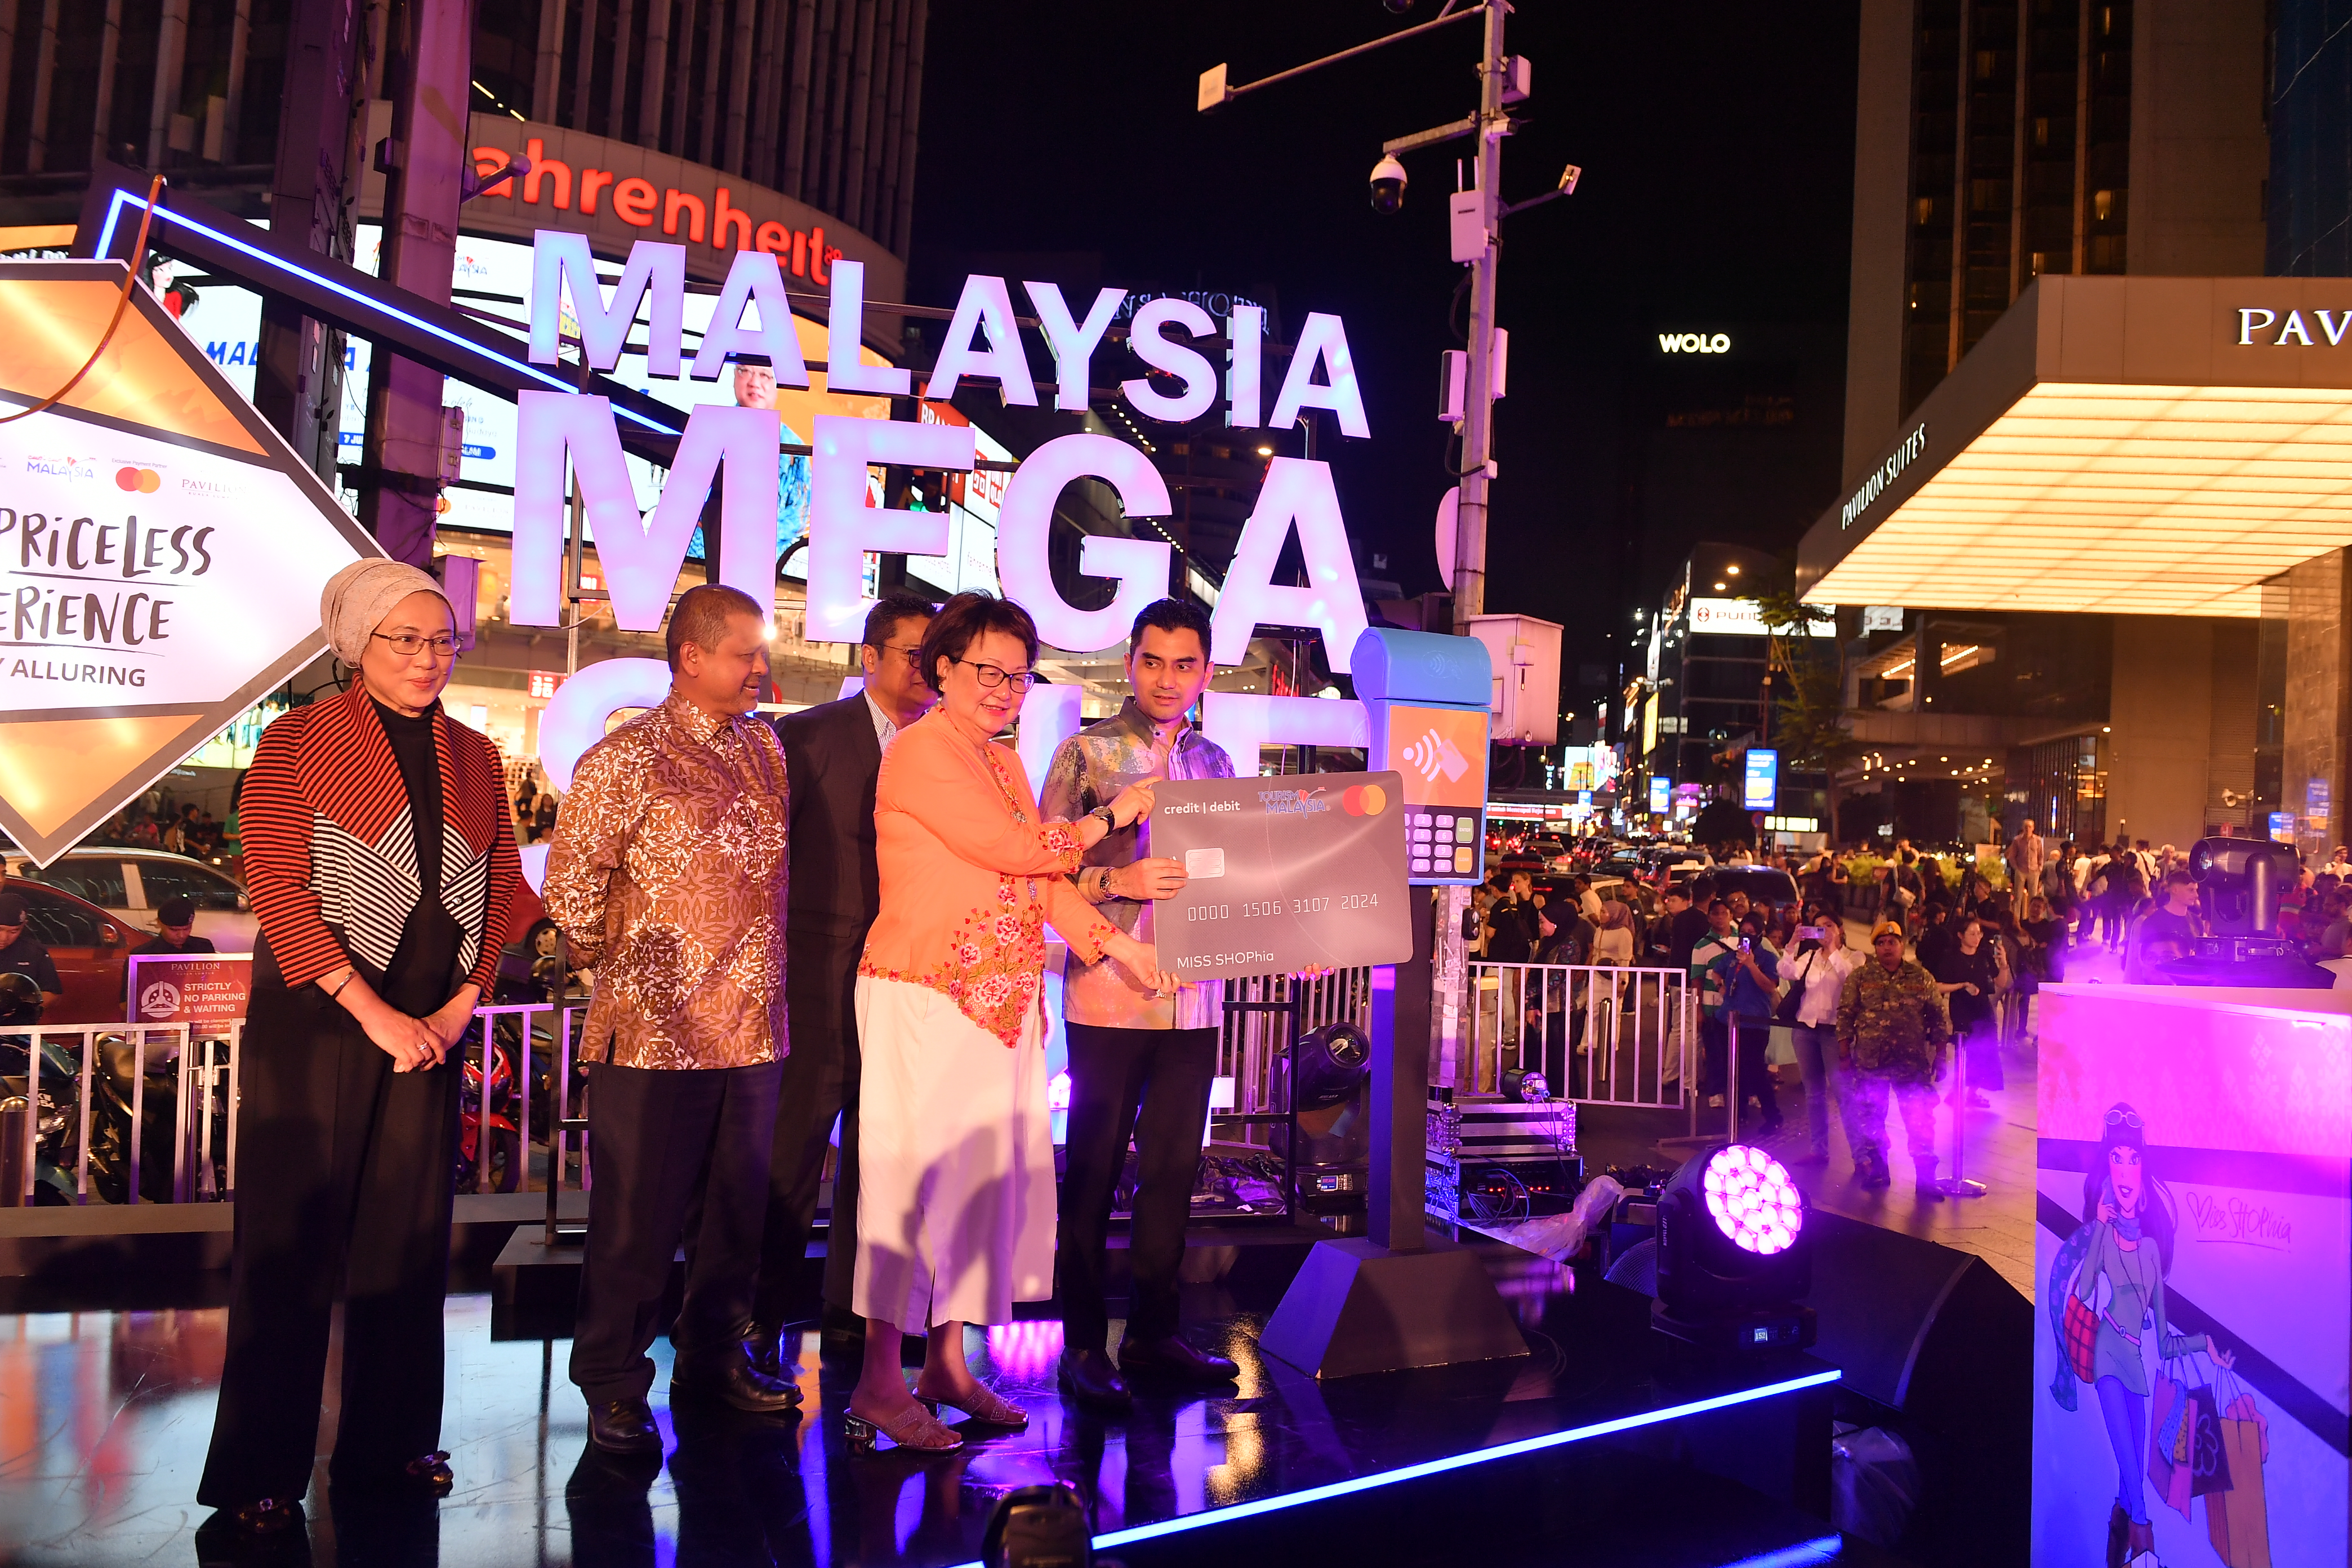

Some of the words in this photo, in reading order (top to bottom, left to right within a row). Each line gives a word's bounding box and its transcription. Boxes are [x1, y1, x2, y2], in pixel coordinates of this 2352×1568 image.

[528, 229, 1371, 439] MALAYSIA
[2238, 308, 2352, 346] PAV
[1659, 333, 1731, 354] WOLO
[27, 461, 93, 483] MALAYSIA
[1841, 466, 1885, 531] PAVILION
[1885, 421, 1926, 487] SUITES
[182, 479, 247, 493] PAVILION
[509, 389, 1371, 675] MEGA
[10, 658, 146, 688] ALLURING
[1258, 790, 1300, 802] TOURISM
[1164, 802, 1200, 815] credit
[1209, 800, 1241, 813] debit
[1188, 905, 1229, 921] 0000
[1242, 901, 1281, 917] 1506
[1293, 897, 1330, 914] 3107
[1341, 893, 1379, 910] 2024
[1177, 954, 1211, 969] MISS
[1215, 950, 1274, 966] SHOPhia
[184, 982, 231, 991] STRICTLY
[184, 994, 199, 1002] NO
[202, 993, 246, 1002] PARKING
[193, 1004, 235, 1013] WAITING
[1755, 1331, 1766, 1340] 152
